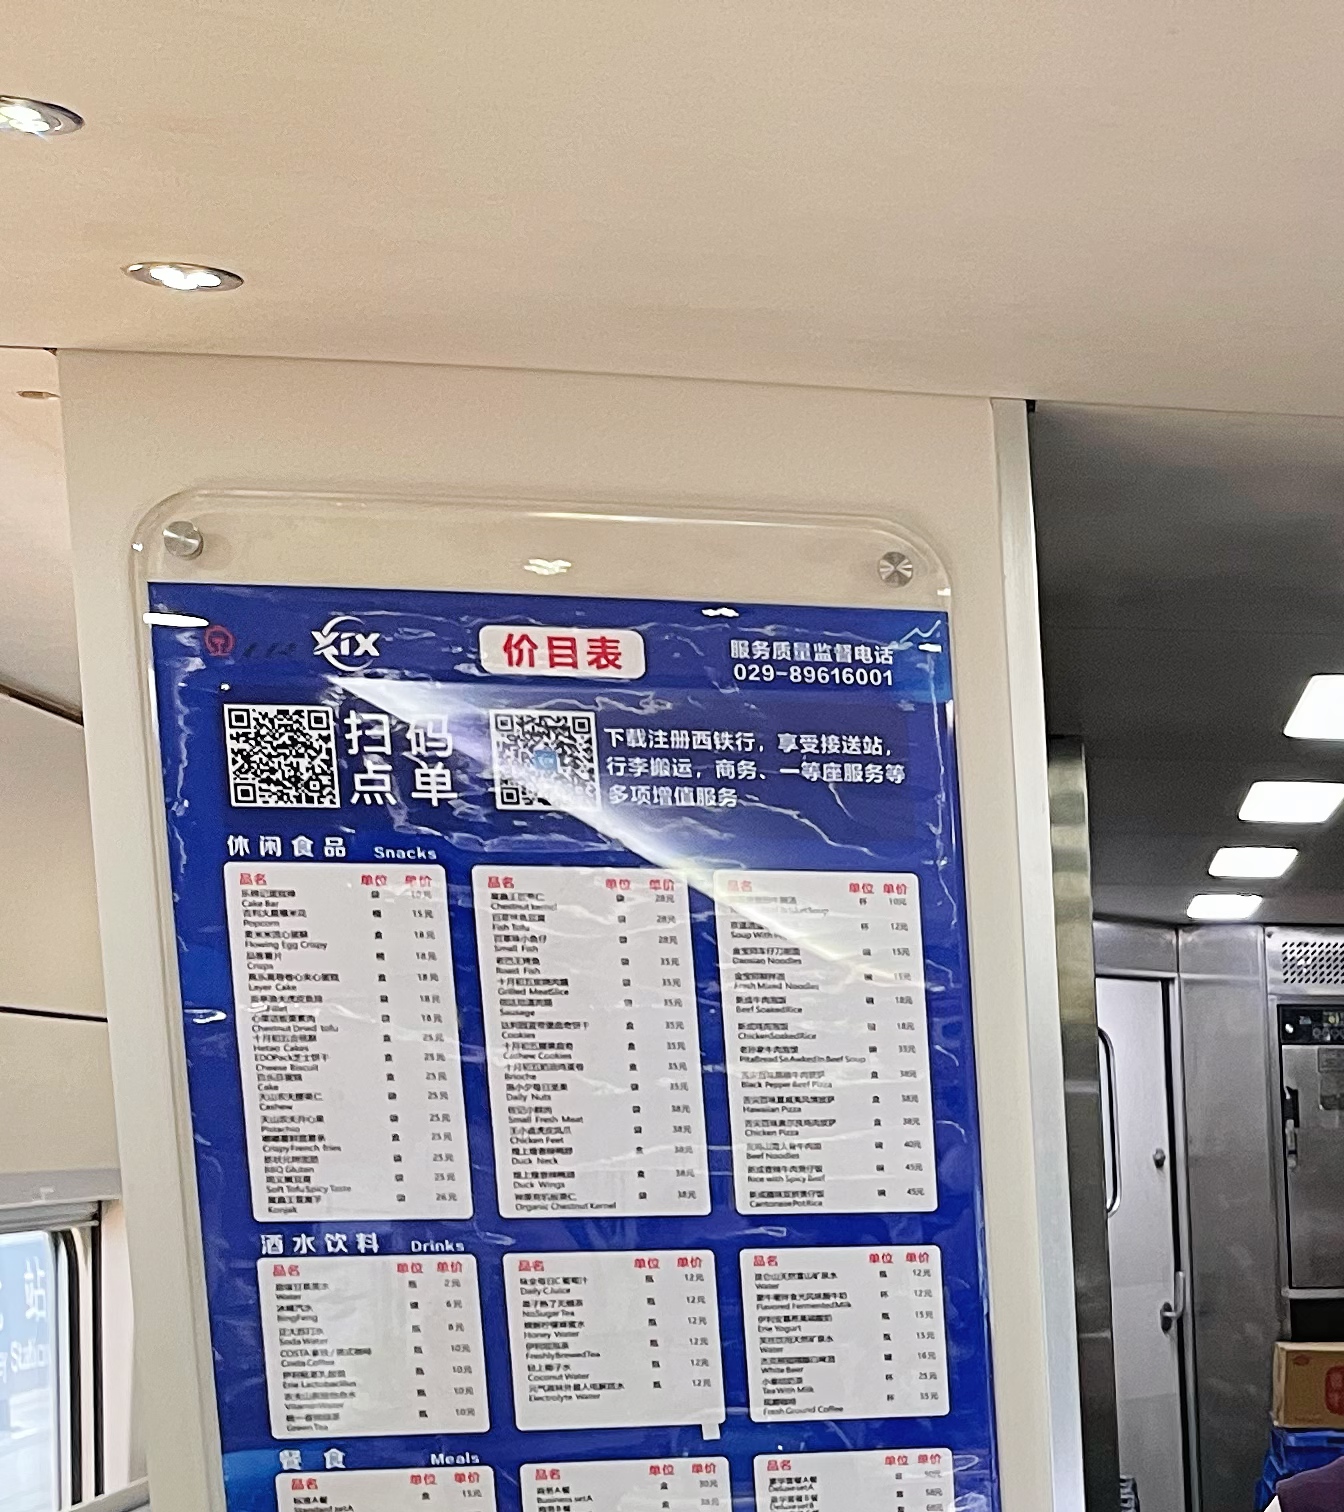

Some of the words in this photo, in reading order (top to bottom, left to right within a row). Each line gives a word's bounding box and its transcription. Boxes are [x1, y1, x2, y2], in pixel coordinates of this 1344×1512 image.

[503, 633, 621, 672] 价目表
[730, 640, 893, 664] 服务质量监督电话
[733, 664, 893, 686] 029-89616001
[345, 710, 452, 757] 扫码
[351, 760, 458, 807] 点单
[609, 785, 737, 807] 多项增值服务
[227, 836, 346, 857] 休闲食品
[374, 847, 437, 859] Snacks
[261, 1233, 379, 1254] 酒水饮料
[411, 1240, 464, 1252] Drinks
[869, 1253, 893, 1264] 单位
[906, 1252, 929, 1263] 单价
[431, 1452, 480, 1466] Meals
[535, 1469, 561, 1480] 品名
[649, 1464, 674, 1476] 单位
[692, 1463, 716, 1474] 单价
